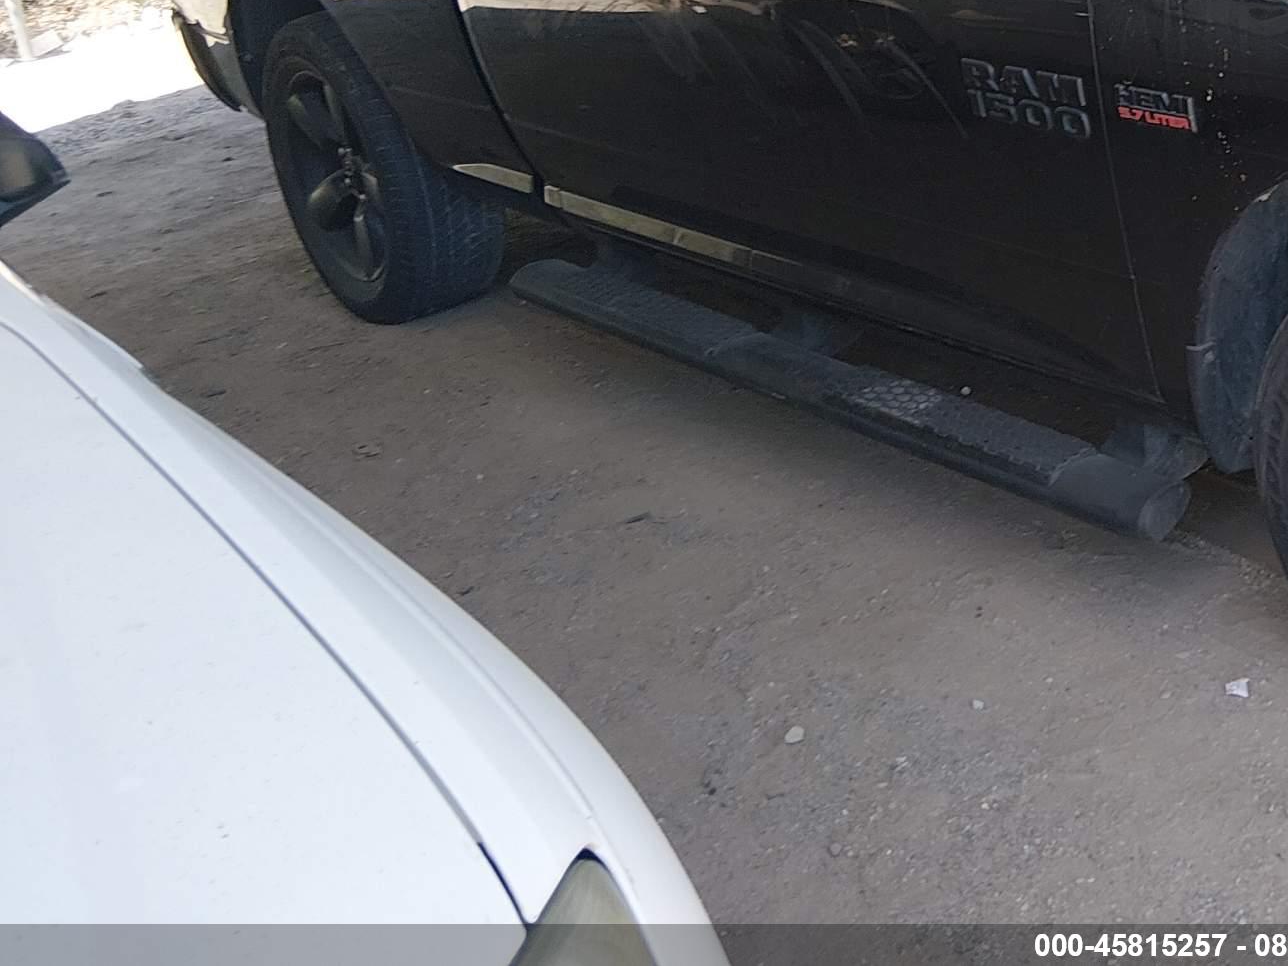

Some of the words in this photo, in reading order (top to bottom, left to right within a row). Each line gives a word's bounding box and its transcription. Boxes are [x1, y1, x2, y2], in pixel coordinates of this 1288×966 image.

[960, 57, 1087, 107] RAM
[966, 88, 1092, 140] 1500
[1113, 82, 1198, 134] HEMI
[1117, 105, 1144, 123] 5.7
[1144, 109, 1192, 131] LITER
